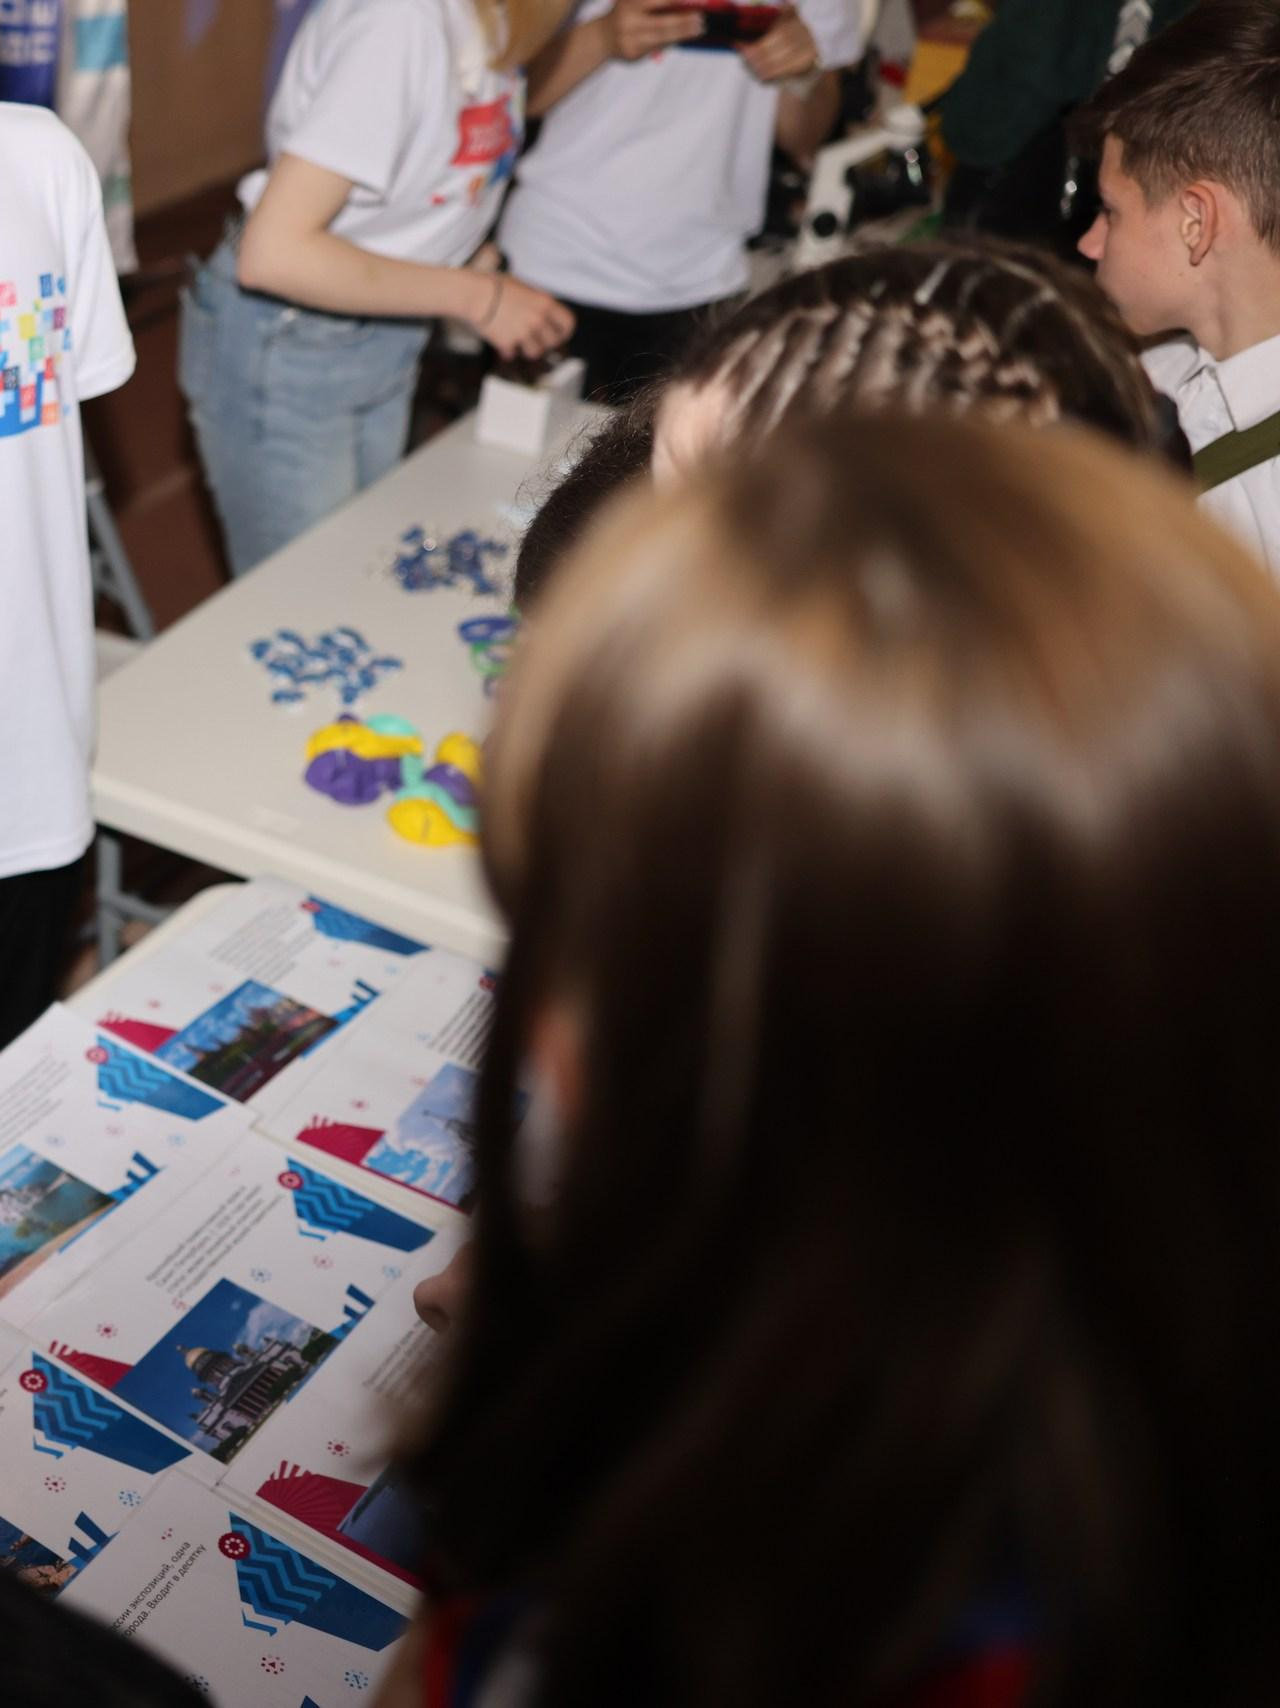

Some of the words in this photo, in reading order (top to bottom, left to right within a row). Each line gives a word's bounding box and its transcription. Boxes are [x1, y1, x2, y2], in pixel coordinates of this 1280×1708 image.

[129, 1563, 175, 1610] экспозиций,
[171, 1542, 191, 1563] одна
[146, 1580, 174, 1609] Входит
[178, 1544, 207, 1577] десятку
